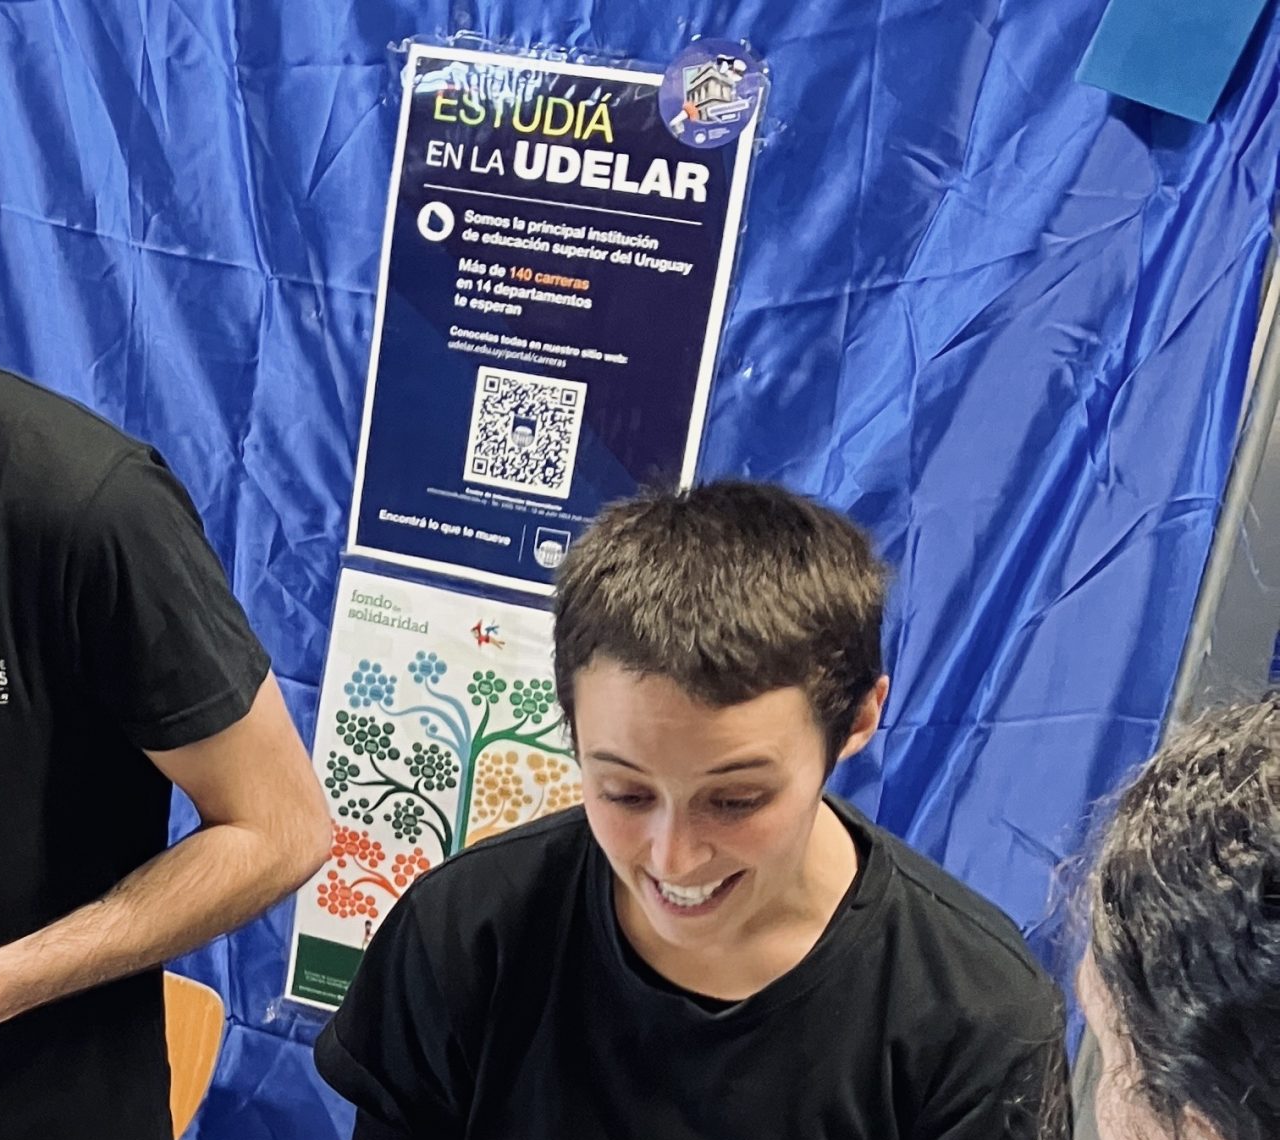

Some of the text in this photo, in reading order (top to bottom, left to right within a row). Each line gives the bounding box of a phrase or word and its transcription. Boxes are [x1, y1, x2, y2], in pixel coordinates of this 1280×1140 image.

[433, 86, 614, 143] ESTUDIÁ
[426, 139, 710, 202] EN LA UDELAR
[464, 209, 659, 250] Somos la principal institución
[461, 228, 694, 276] de educación superior del Uruguay
[458, 257, 590, 290] Más de 140 carreras
[454, 293, 523, 317] te esperan
[456, 278, 593, 309] en 14 departamentos
[500, 334, 528, 349] todas
[529, 340, 542, 351] en
[542, 341, 581, 357] nuestro
[581, 347, 603, 361] sitio
[378, 508, 512, 547] Encontrá lo que te mueve
[350, 588, 393, 609] fondo
[347, 607, 429, 635] solidaridad
